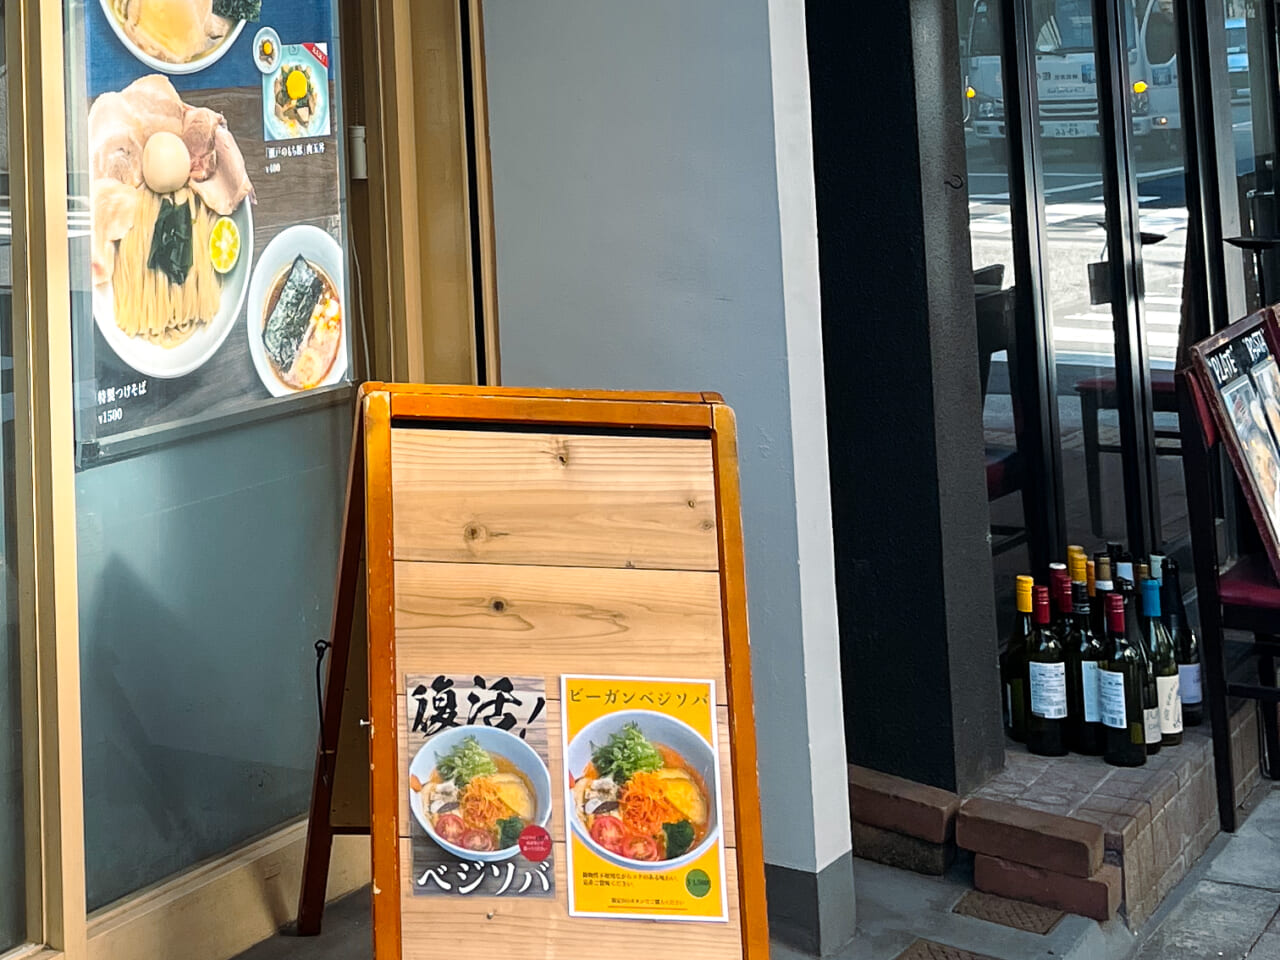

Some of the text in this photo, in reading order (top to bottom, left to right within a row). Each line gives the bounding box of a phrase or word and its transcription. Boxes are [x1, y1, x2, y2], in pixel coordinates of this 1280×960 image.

[569, 688, 709, 707] ビーガンベジソバ
[418, 860, 551, 897] ベジソバ
